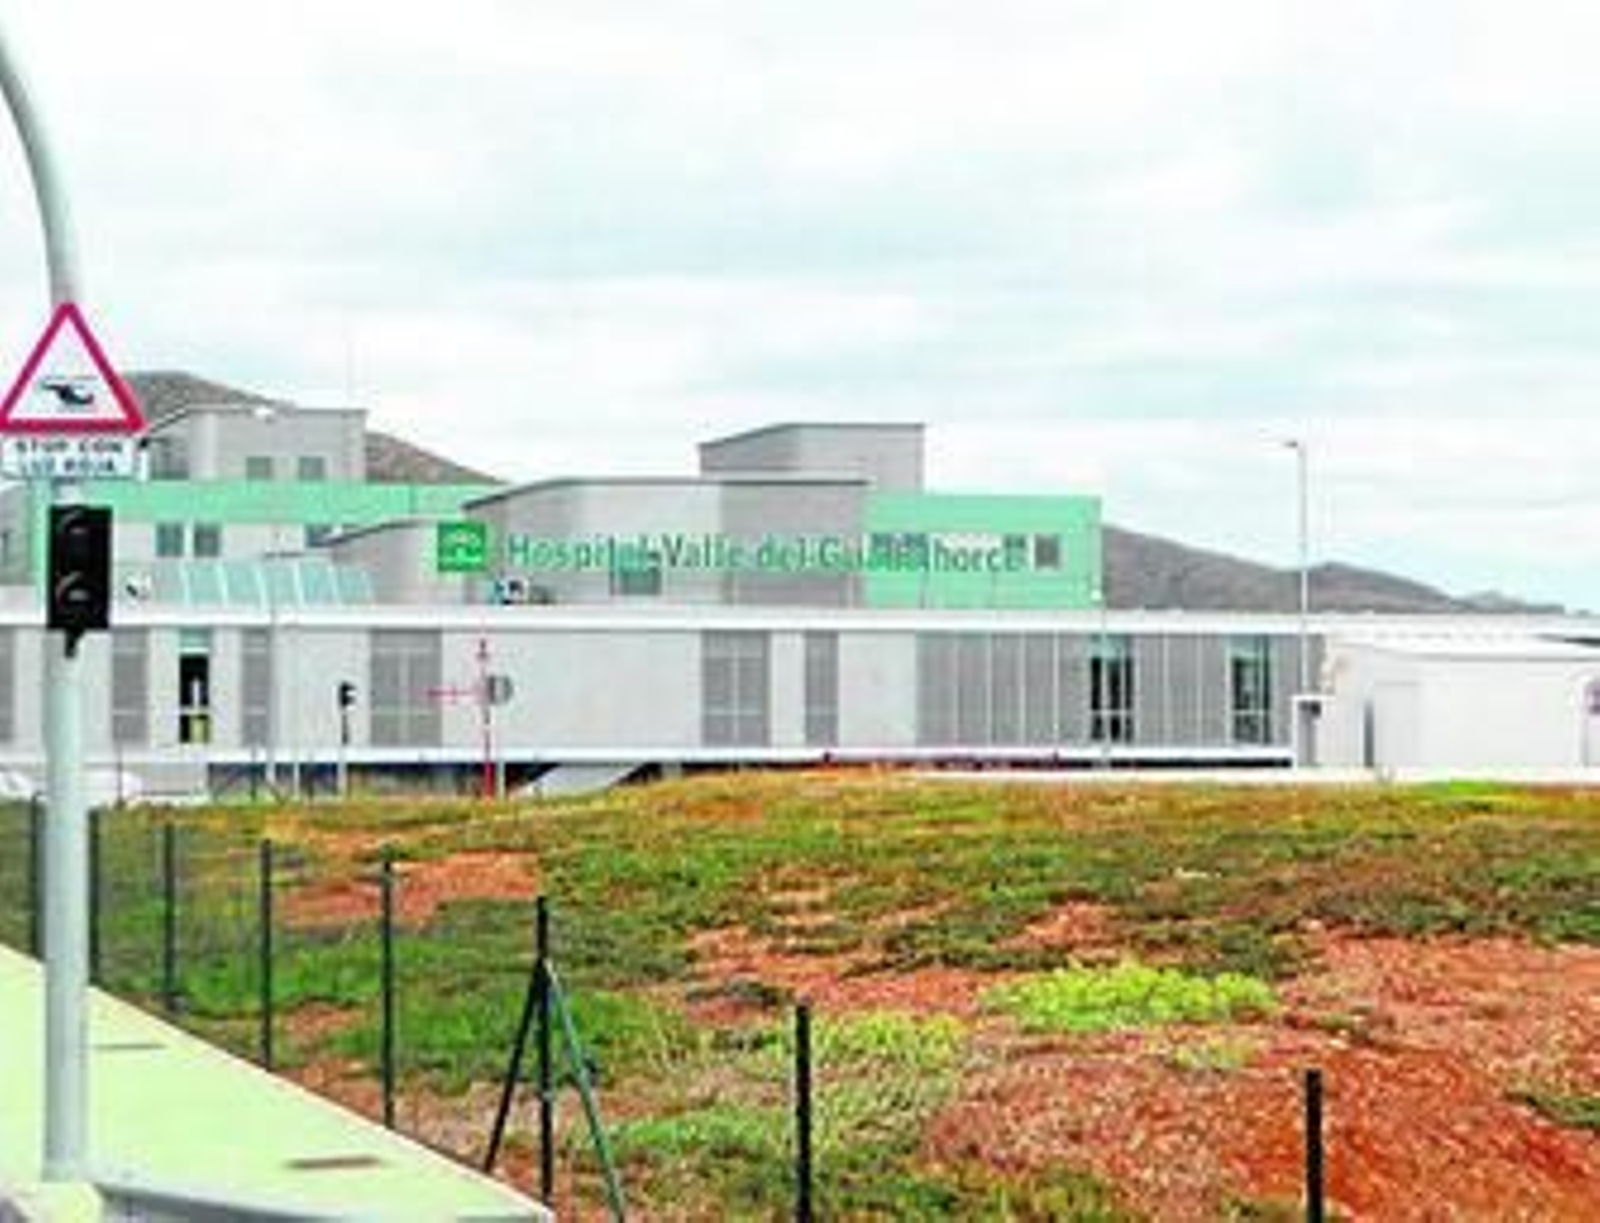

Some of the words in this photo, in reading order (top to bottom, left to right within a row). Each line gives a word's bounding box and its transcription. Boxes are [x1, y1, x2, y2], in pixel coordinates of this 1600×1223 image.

[508, 533, 655, 571] Hospital
[660, 533, 747, 569] Valle
[757, 532, 809, 571] del
